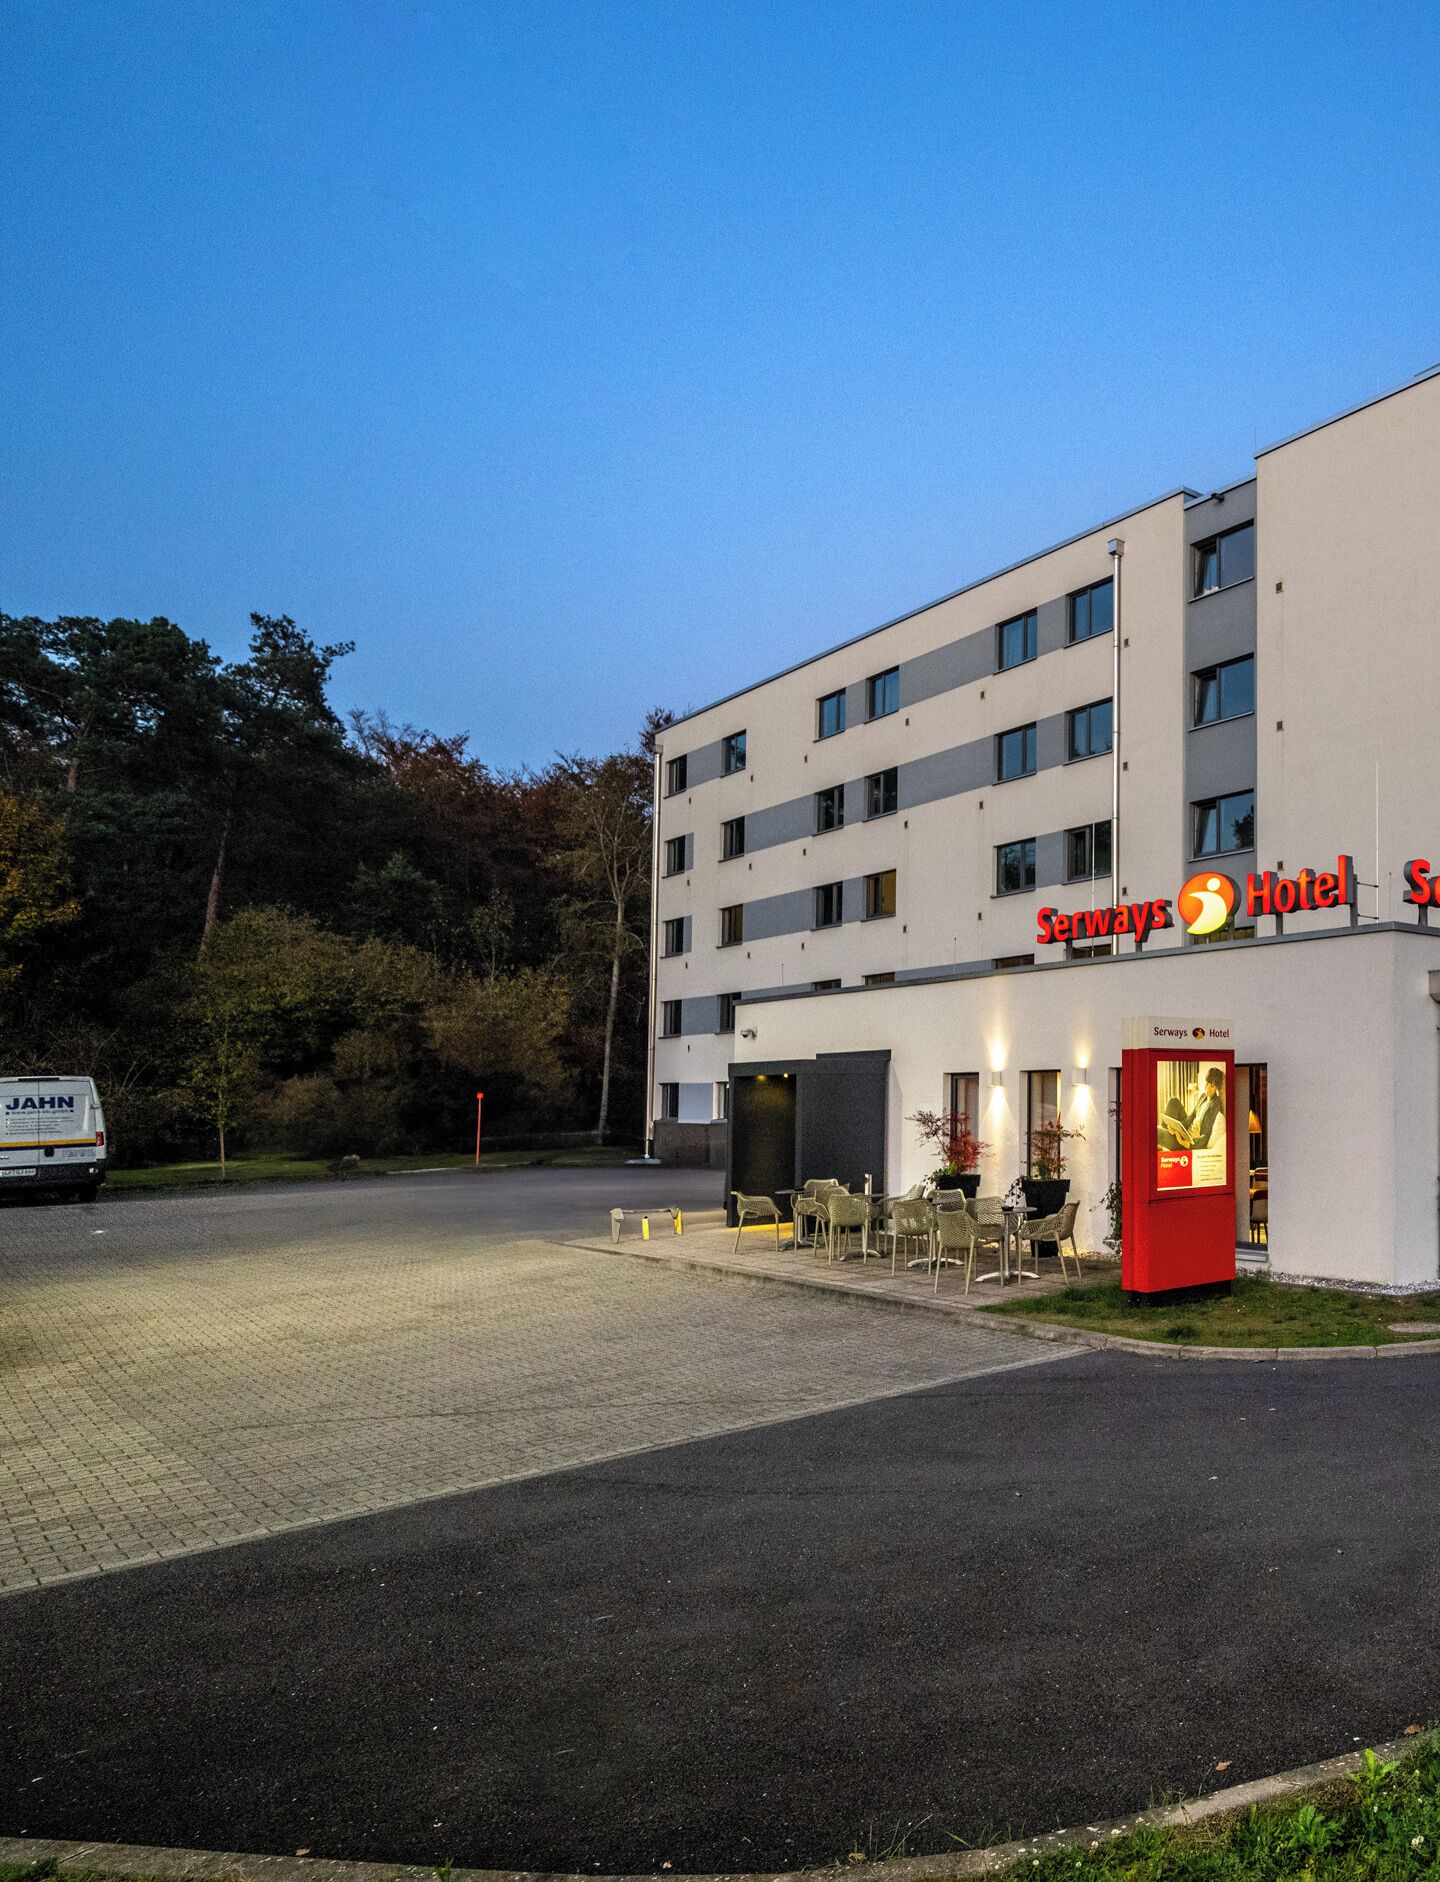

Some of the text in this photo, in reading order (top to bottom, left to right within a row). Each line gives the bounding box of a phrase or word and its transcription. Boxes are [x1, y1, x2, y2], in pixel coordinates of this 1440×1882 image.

[1037, 855, 1351, 943] Serways Hotel
[1154, 1027, 1230, 1039] Serways Hotel
[5, 1096, 74, 1110] JAHN
